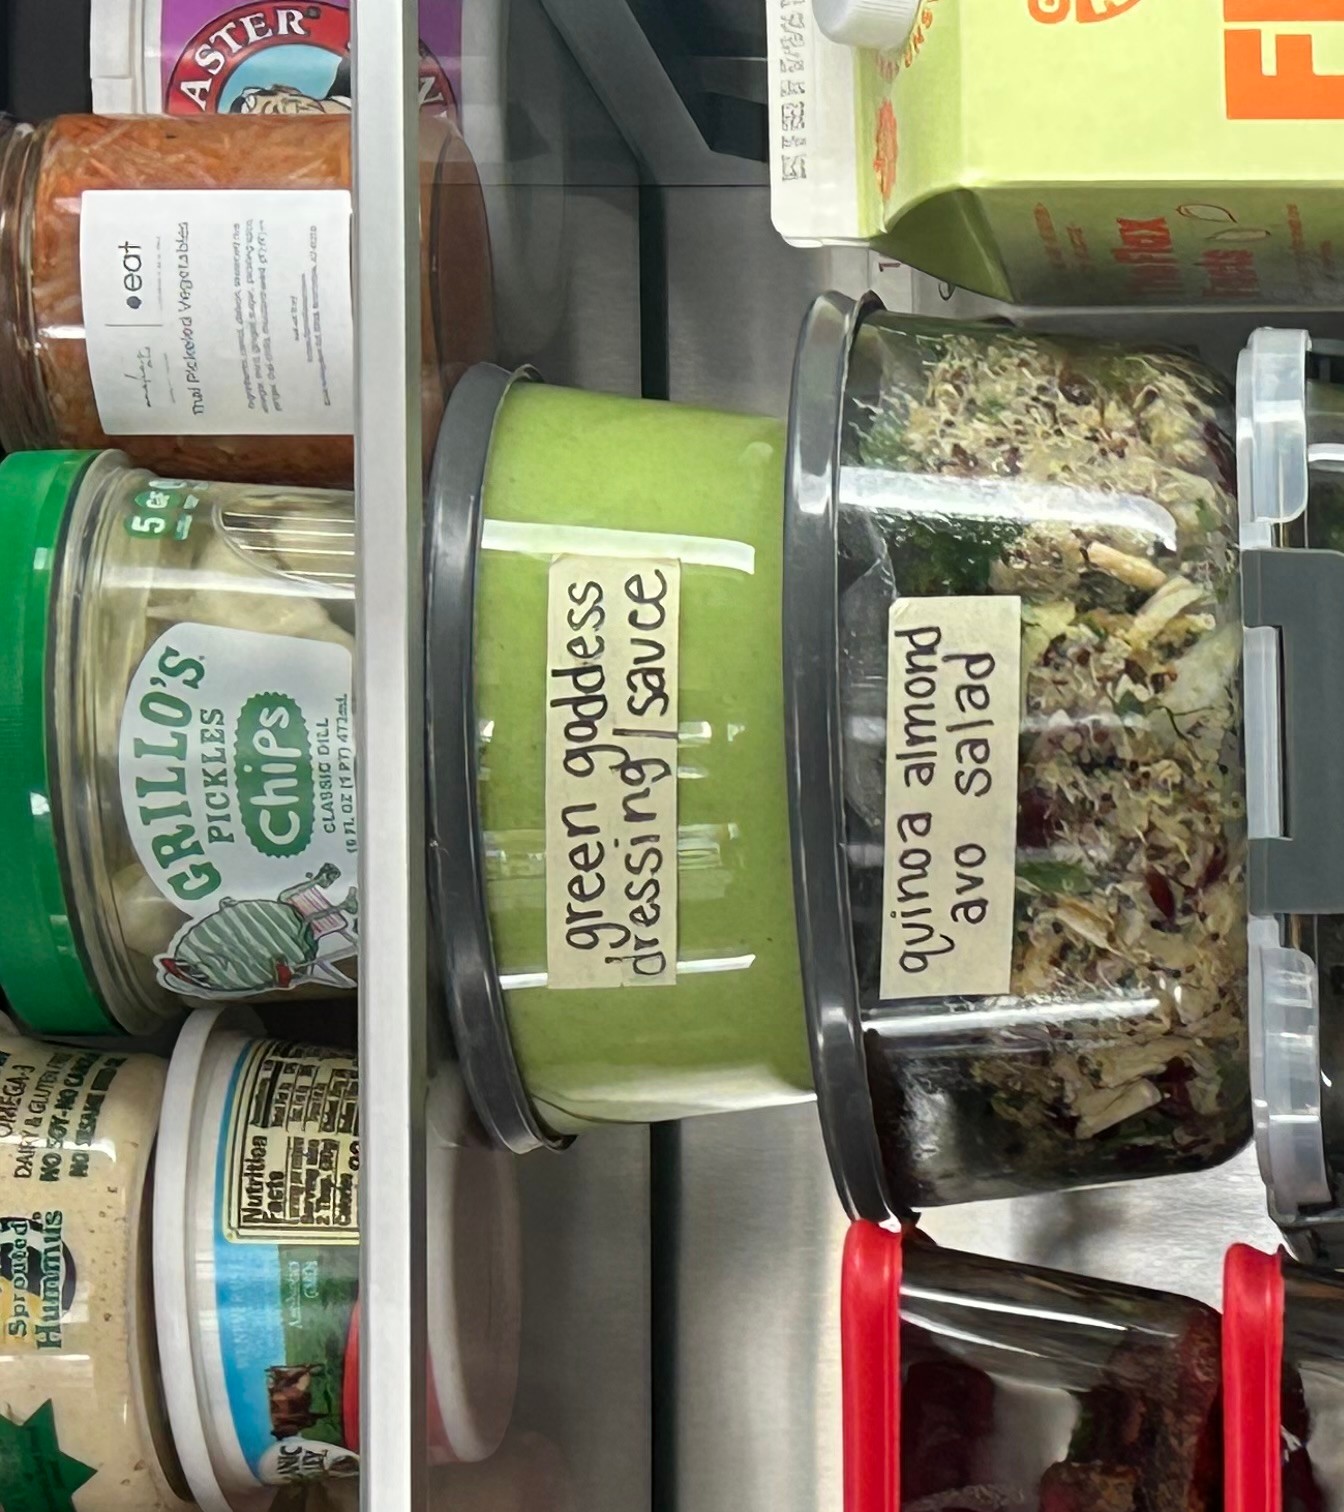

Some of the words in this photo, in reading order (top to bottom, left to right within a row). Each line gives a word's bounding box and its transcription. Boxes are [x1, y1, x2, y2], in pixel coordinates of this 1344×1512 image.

[117, 240, 142, 292] eat
[550, 579, 628, 778] goddess
[894, 626, 942, 788] almond
[941, 651, 996, 798] salad
[132, 645, 222, 901] GRILLO'S
[199, 707, 235, 842] PICKLES
[559, 802, 632, 950] green
[889, 811, 955, 973] quinoa
[947, 842, 989, 925] avo
[8, 1218, 30, 1338] Sprouted
[34, 1209, 64, 1350] Hummus
